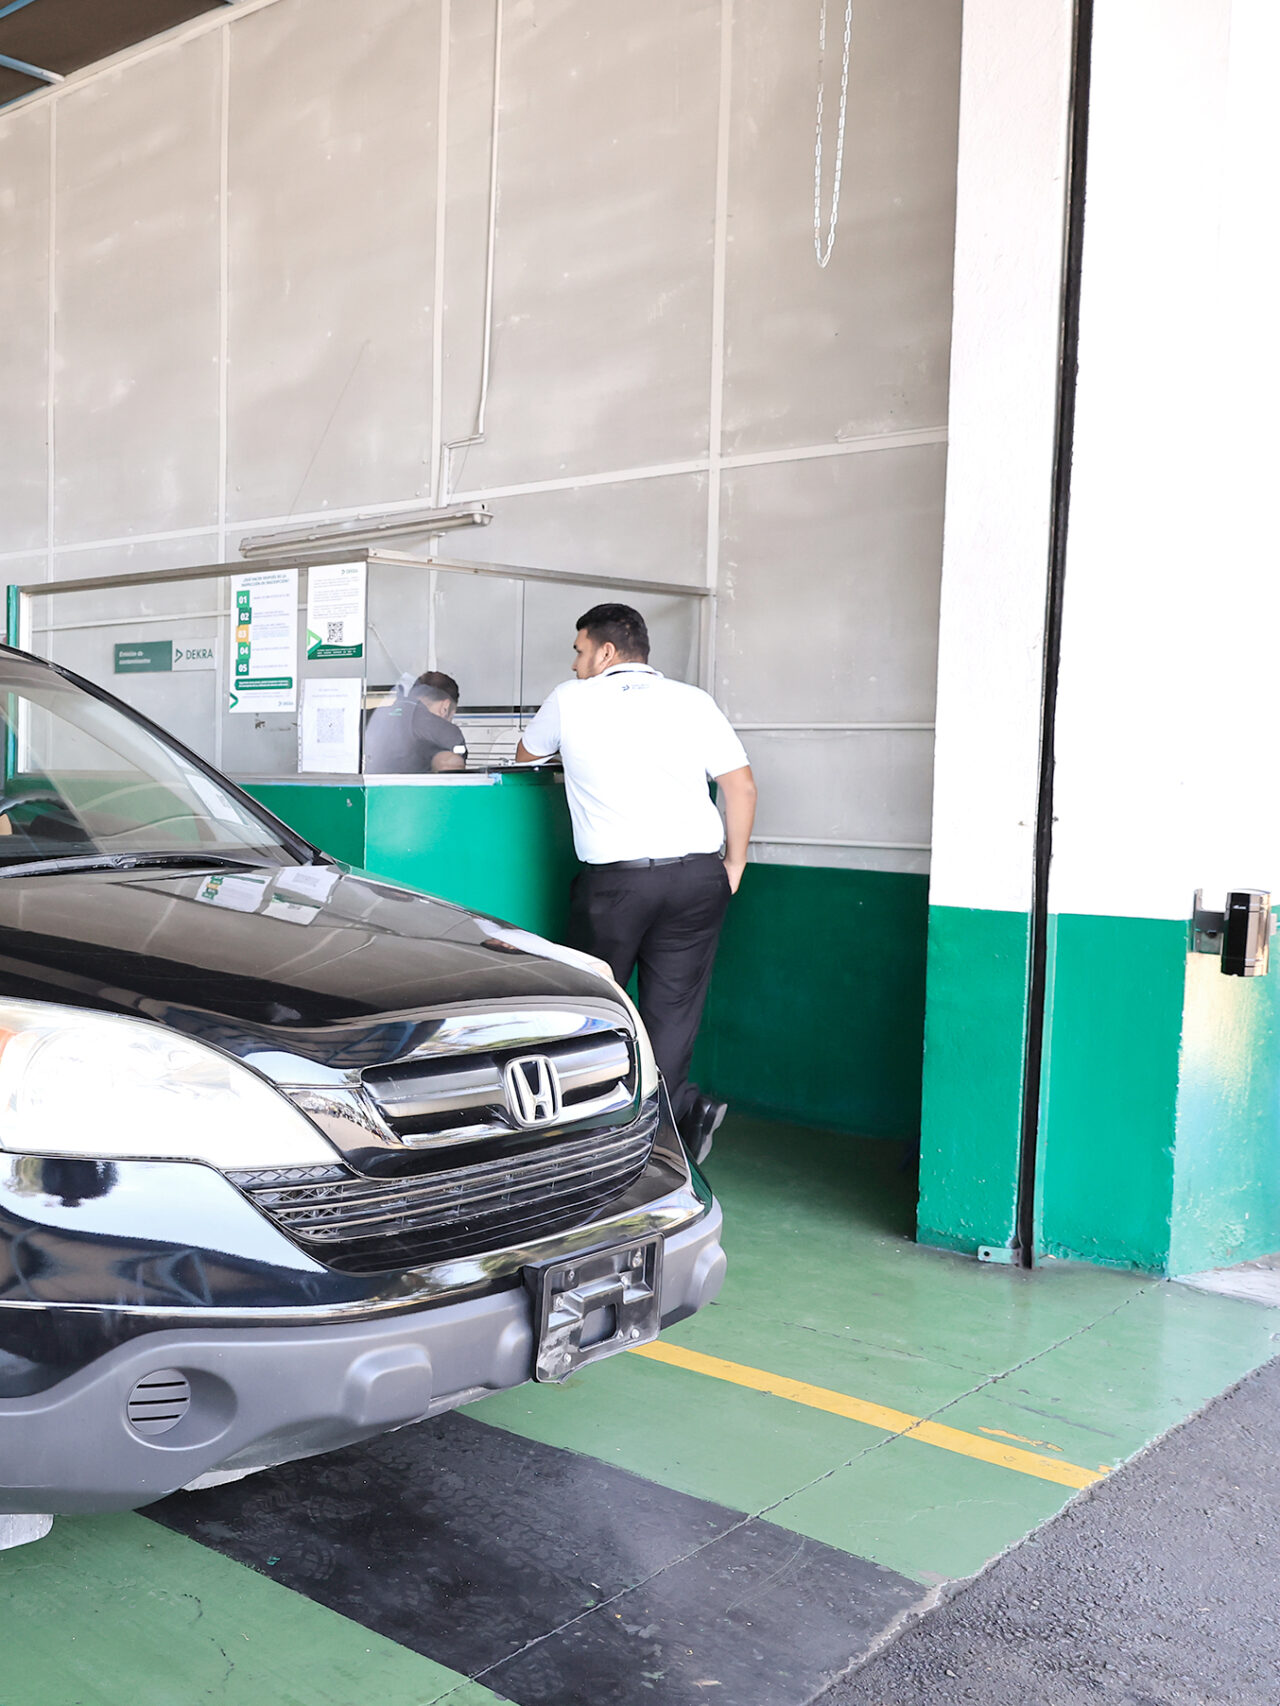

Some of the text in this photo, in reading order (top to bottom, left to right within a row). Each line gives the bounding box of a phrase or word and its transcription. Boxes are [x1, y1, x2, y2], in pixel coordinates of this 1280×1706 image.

[238, 595, 248, 604] 01
[240, 612, 250, 621] 02
[237, 630, 247, 639] 03
[185, 648, 214, 660] DEKRA
[240, 646, 249, 655] 04
[238, 663, 248, 672] 05
